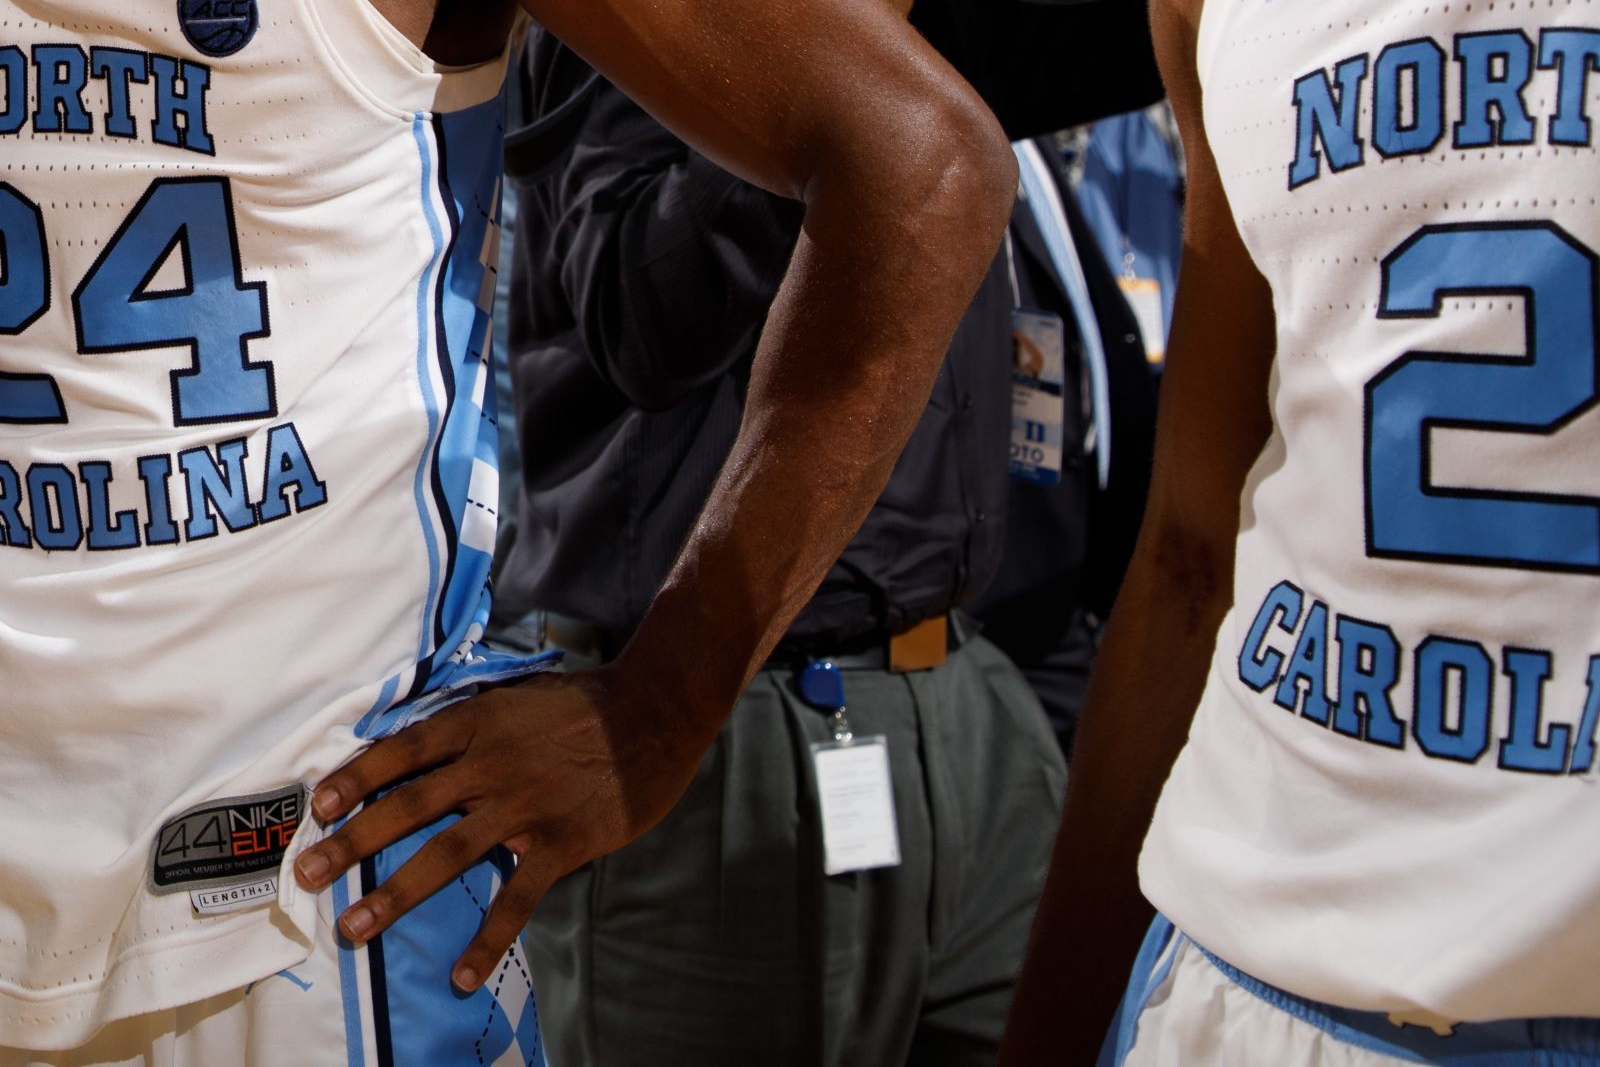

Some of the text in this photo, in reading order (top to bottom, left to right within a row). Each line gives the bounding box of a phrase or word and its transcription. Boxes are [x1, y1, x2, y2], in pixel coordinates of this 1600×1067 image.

[1363, 219, 1600, 574] 2
[228, 797, 297, 833] NIKE
[160, 815, 228, 859] 44
[231, 820, 297, 857] ELITE
